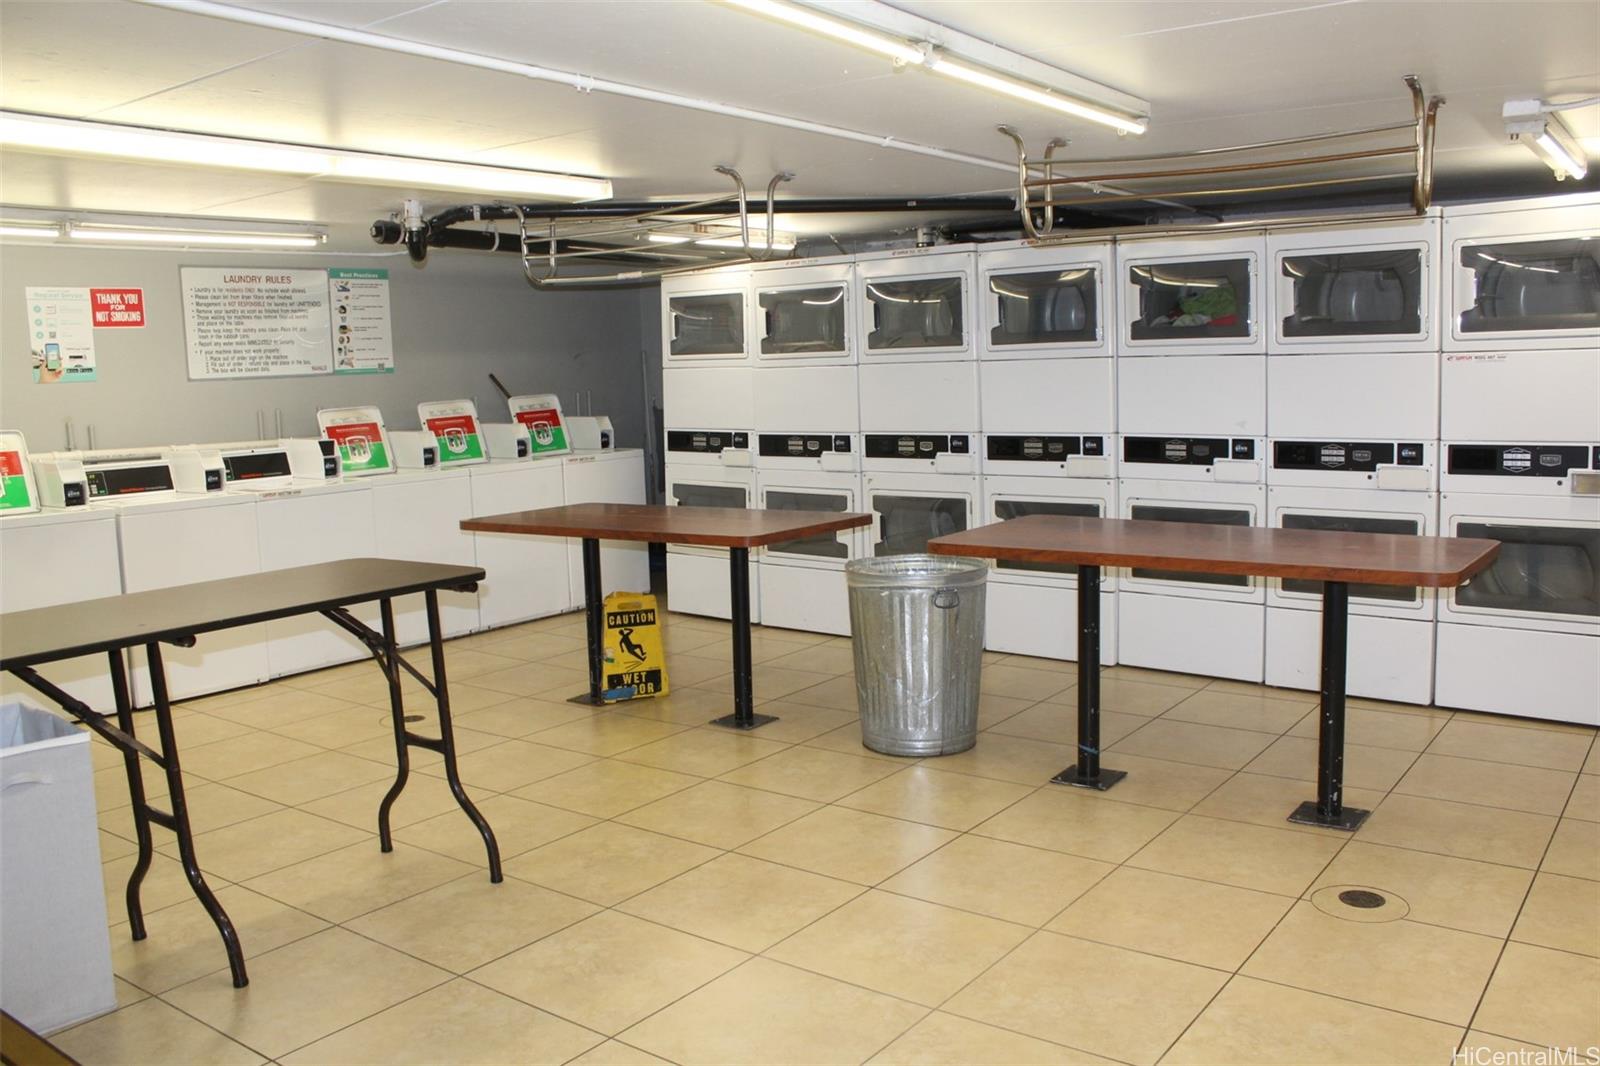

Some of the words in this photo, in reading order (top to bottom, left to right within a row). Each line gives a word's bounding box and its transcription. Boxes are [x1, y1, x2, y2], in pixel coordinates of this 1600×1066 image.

[224, 275, 262, 284] LAUNDRY
[266, 276, 292, 284] RULES
[96, 294, 121, 304] THANK
[124, 294, 138, 304] YOU
[96, 312, 110, 322] NOT
[110, 312, 141, 322] SMOKING
[608, 612, 655, 626] CAUTION
[622, 672, 647, 684] WET
